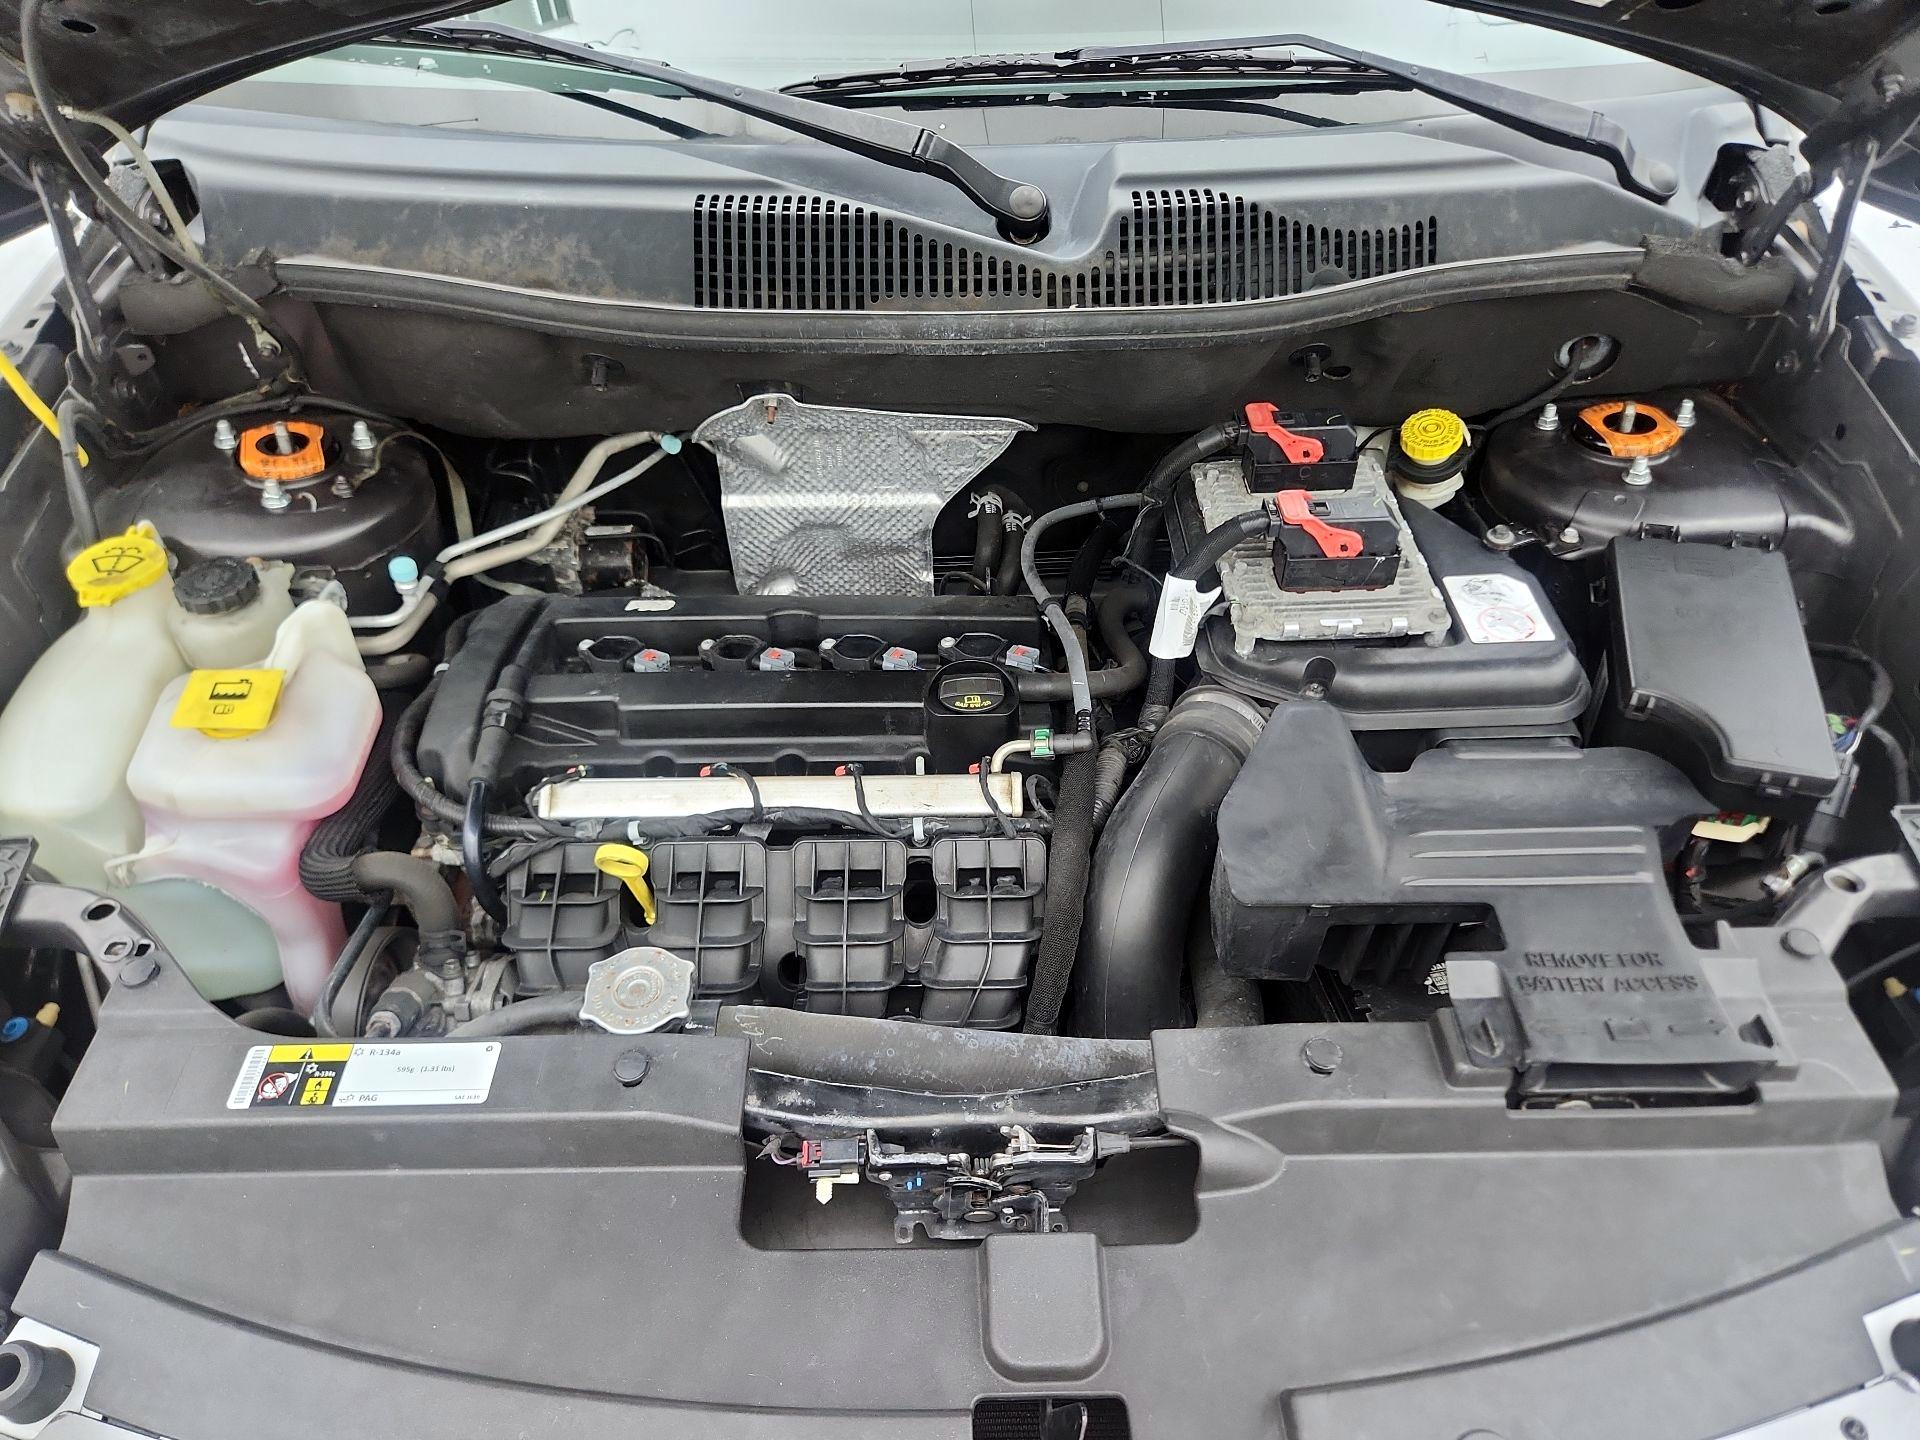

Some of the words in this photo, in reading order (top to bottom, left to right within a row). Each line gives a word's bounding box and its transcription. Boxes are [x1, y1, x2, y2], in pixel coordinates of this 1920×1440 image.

[1524, 951, 1610, 968] REMOVE
[1616, 951, 1664, 968] FOR
[1516, 975, 1606, 992] BATTERY
[1613, 975, 1699, 993] ACCESS
[369, 1048, 401, 1056] R-134a
[396, 1066, 416, 1074] 595g
[420, 1065, 440, 1073] (1.31
[358, 1094, 379, 1102] PAG
